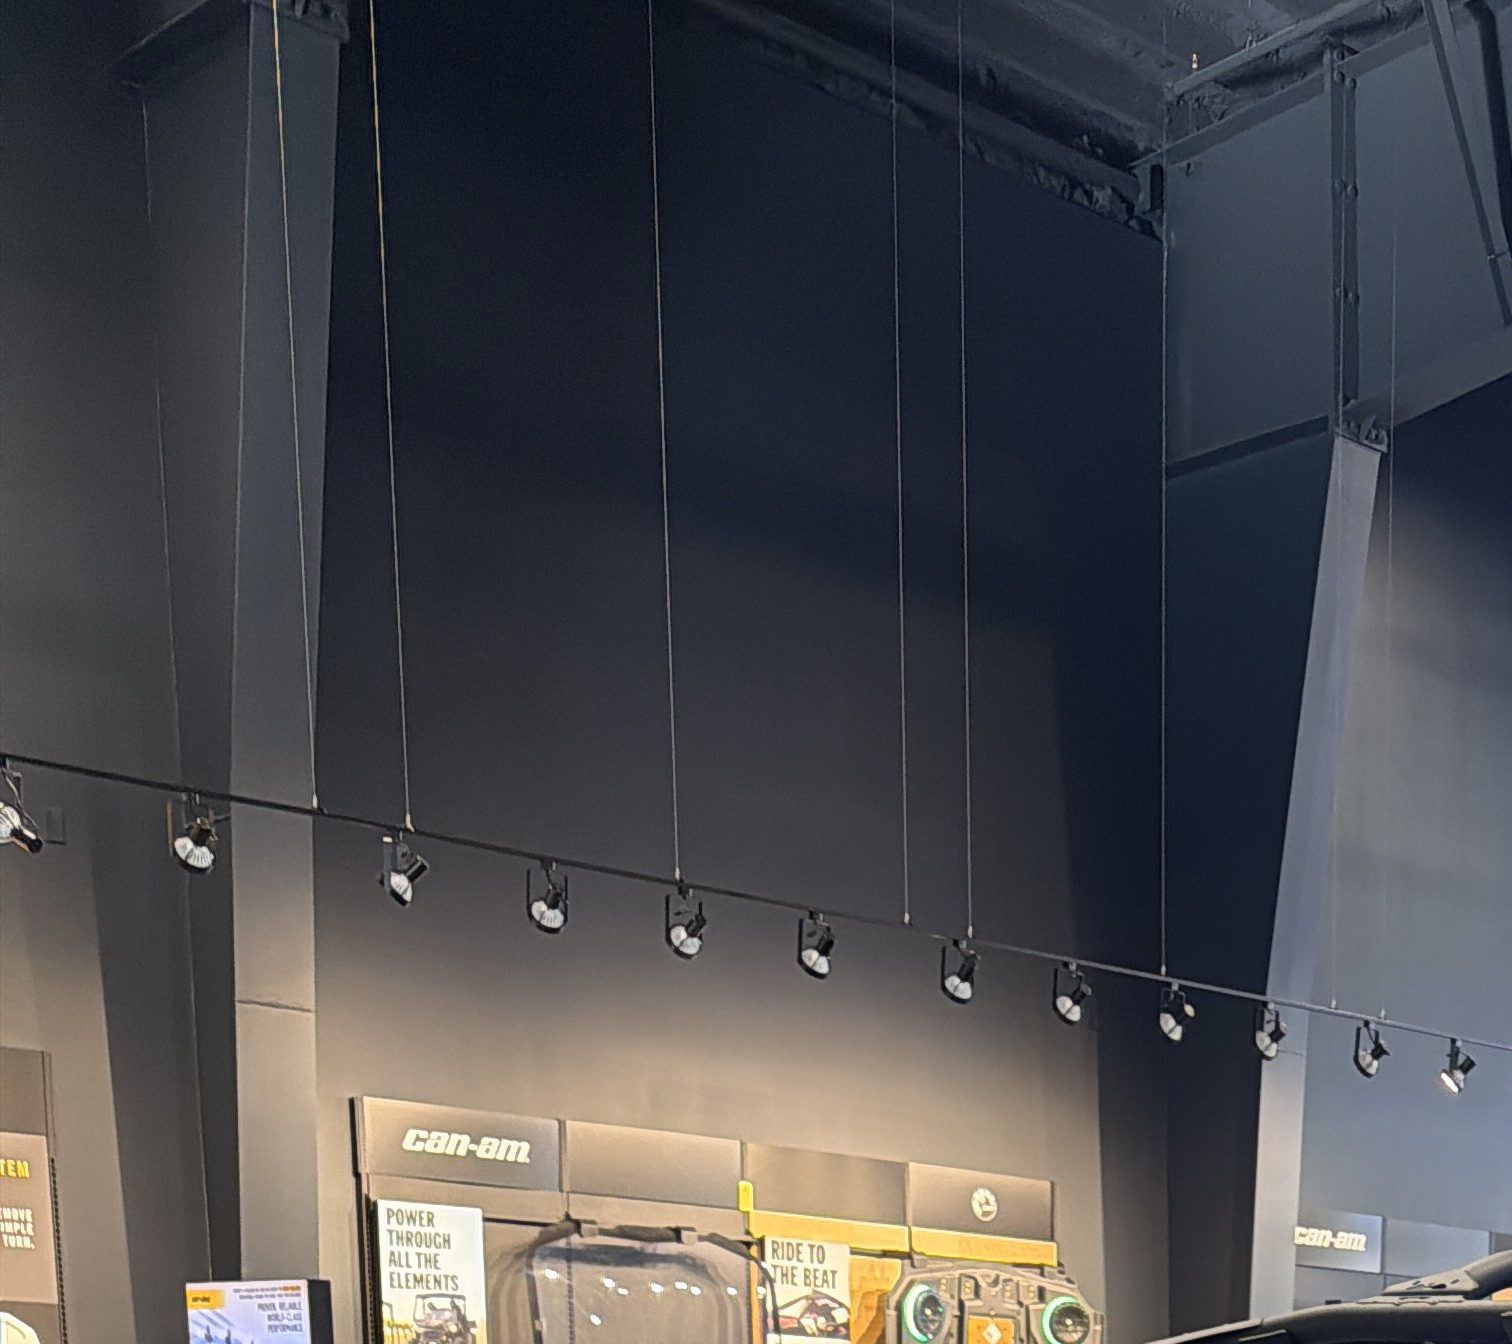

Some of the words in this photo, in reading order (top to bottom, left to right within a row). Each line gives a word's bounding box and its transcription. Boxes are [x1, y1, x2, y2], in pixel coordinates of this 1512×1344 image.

[401, 1128, 531, 1164] can-am
[0, 1206, 33, 1223] MOVE
[386, 1207, 436, 1228] POWER
[386, 1228, 452, 1250] THROUGH
[1293, 1226, 1367, 1252] can-am
[388, 1249, 413, 1269] ALL
[414, 1251, 442, 1271] THE
[771, 1239, 804, 1264] RIDE
[807, 1243, 826, 1266] TO
[388, 1270, 460, 1292] ELEMENTS
[770, 1263, 799, 1287] THE
[803, 1267, 838, 1290] BEAT
